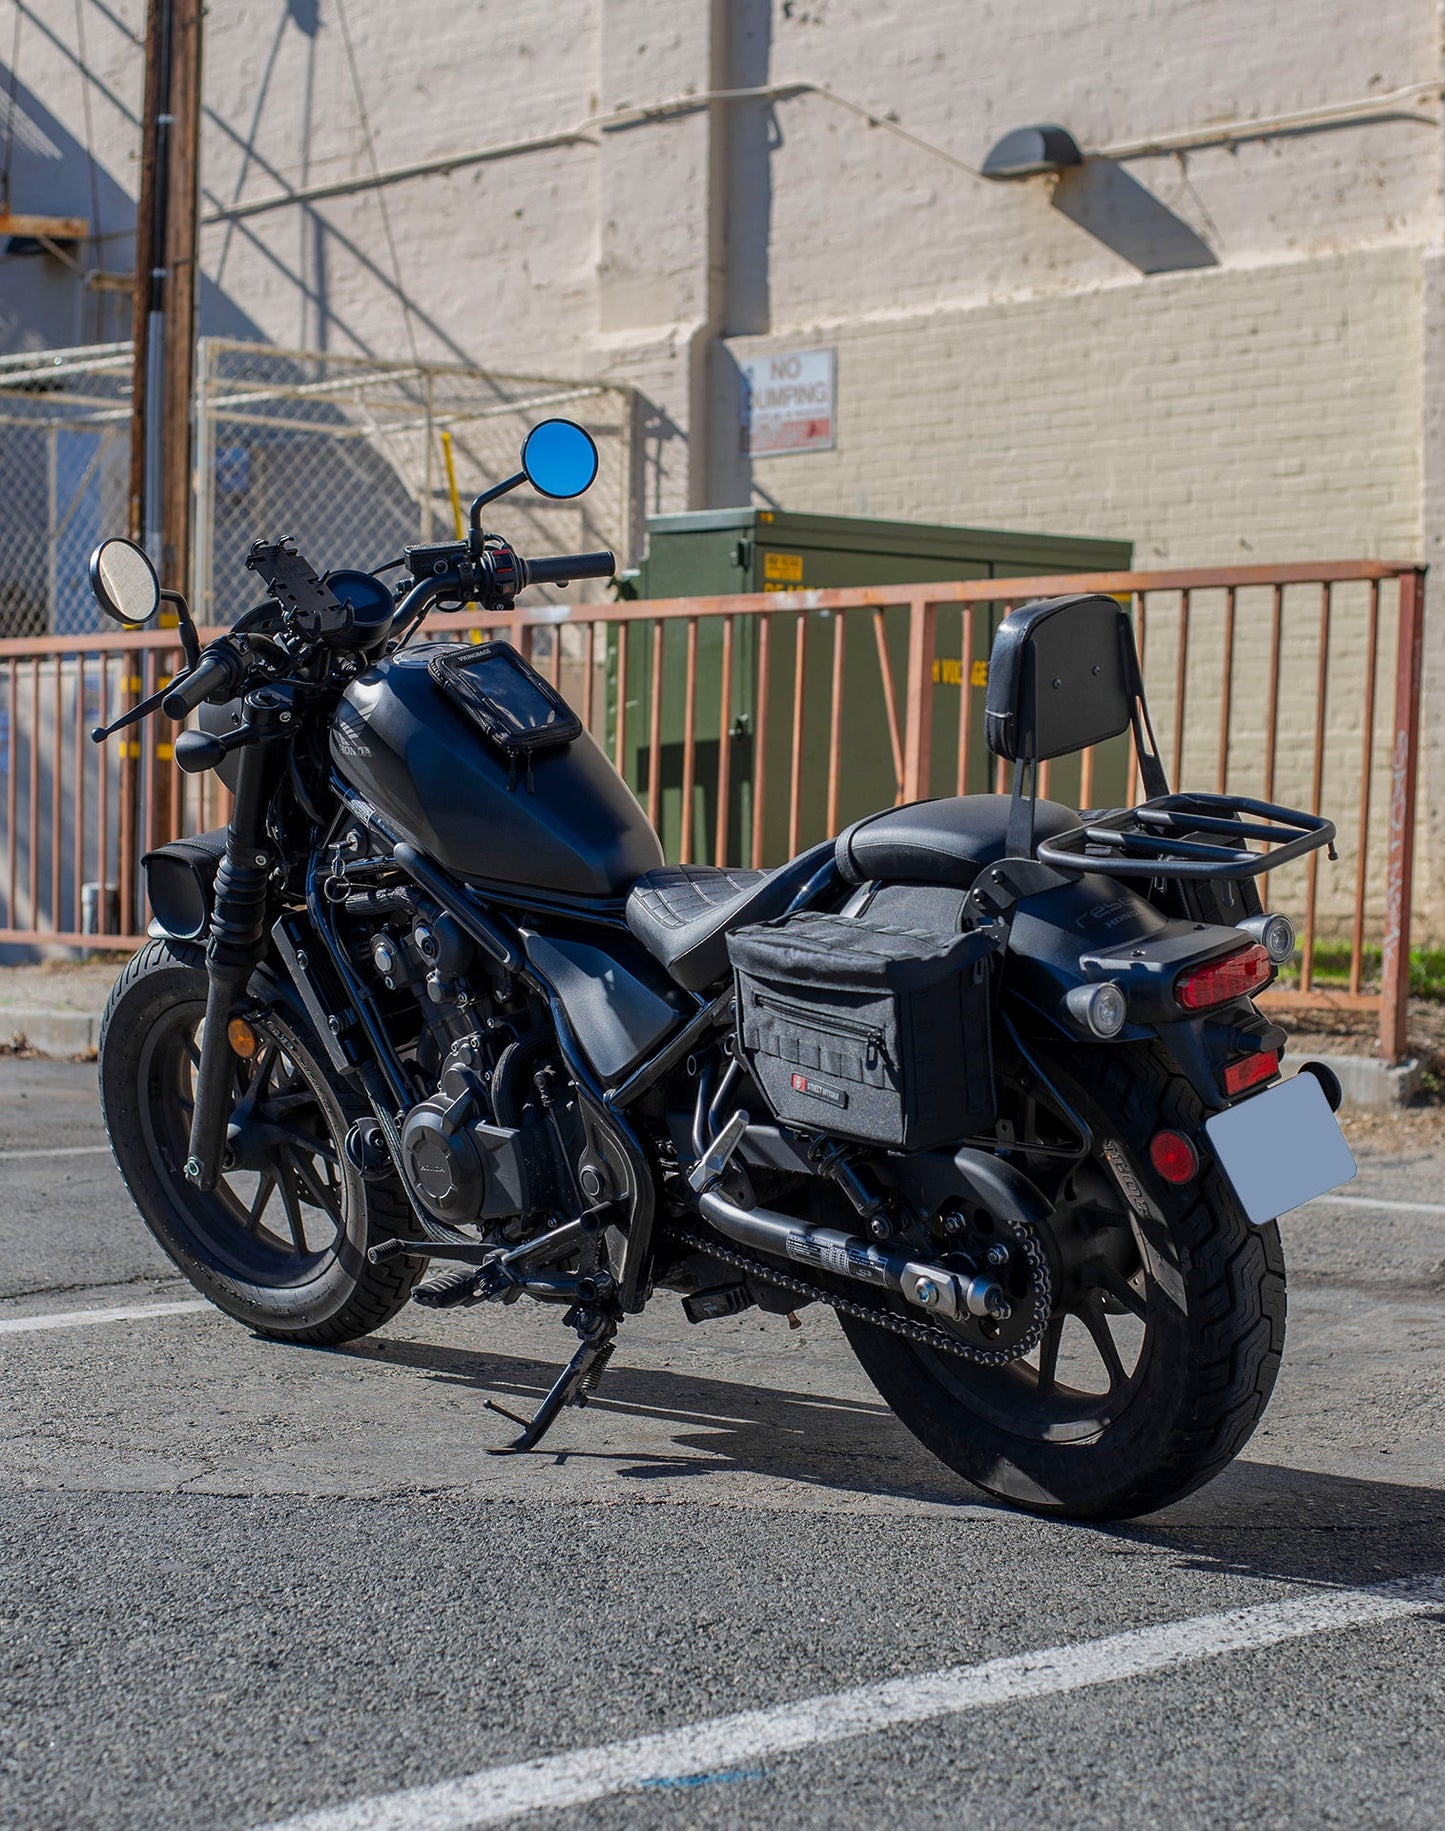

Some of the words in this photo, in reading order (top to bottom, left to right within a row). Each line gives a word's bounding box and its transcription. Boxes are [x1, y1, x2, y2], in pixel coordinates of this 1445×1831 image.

[769, 356, 802, 381] NO
[942, 658, 988, 687] VOLGE
[1076, 896, 1134, 929] rebe
[1104, 909, 1140, 929] HOND
